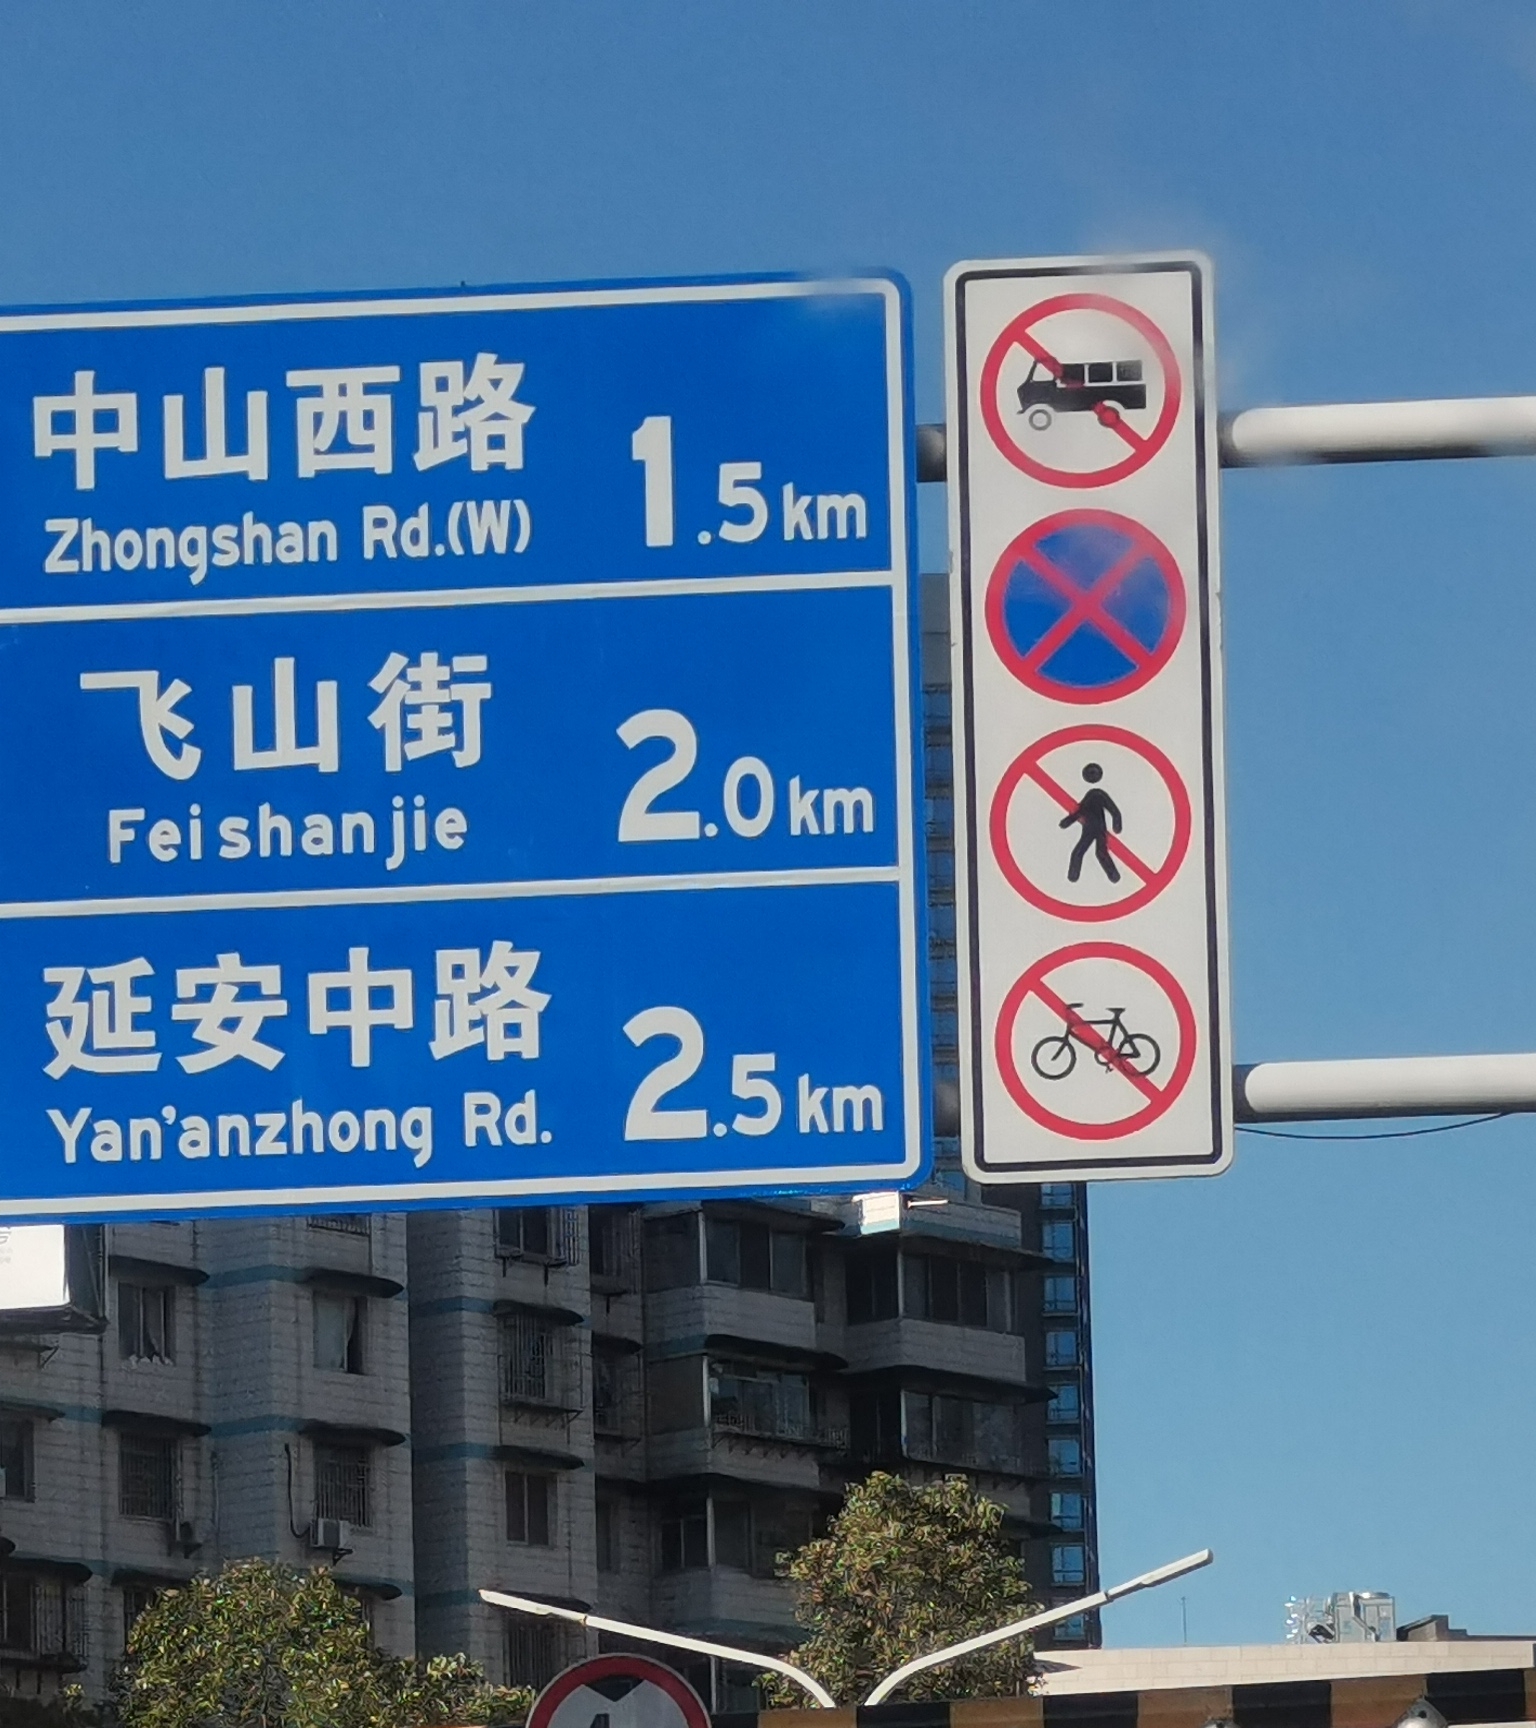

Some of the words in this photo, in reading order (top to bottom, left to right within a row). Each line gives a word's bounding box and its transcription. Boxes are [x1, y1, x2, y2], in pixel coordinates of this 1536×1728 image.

[33, 352, 535, 491] 中山西路
[45, 512, 337, 585] Zhongshan
[363, 499, 532, 560] Rd.(W)
[80, 652, 493, 781] 飞山街
[109, 796, 469, 870] Feishanjie
[43, 940, 552, 1081] 延安中路
[47, 1099, 433, 1169] Yan'anzhong
[464, 1089, 553, 1148] Rd.
